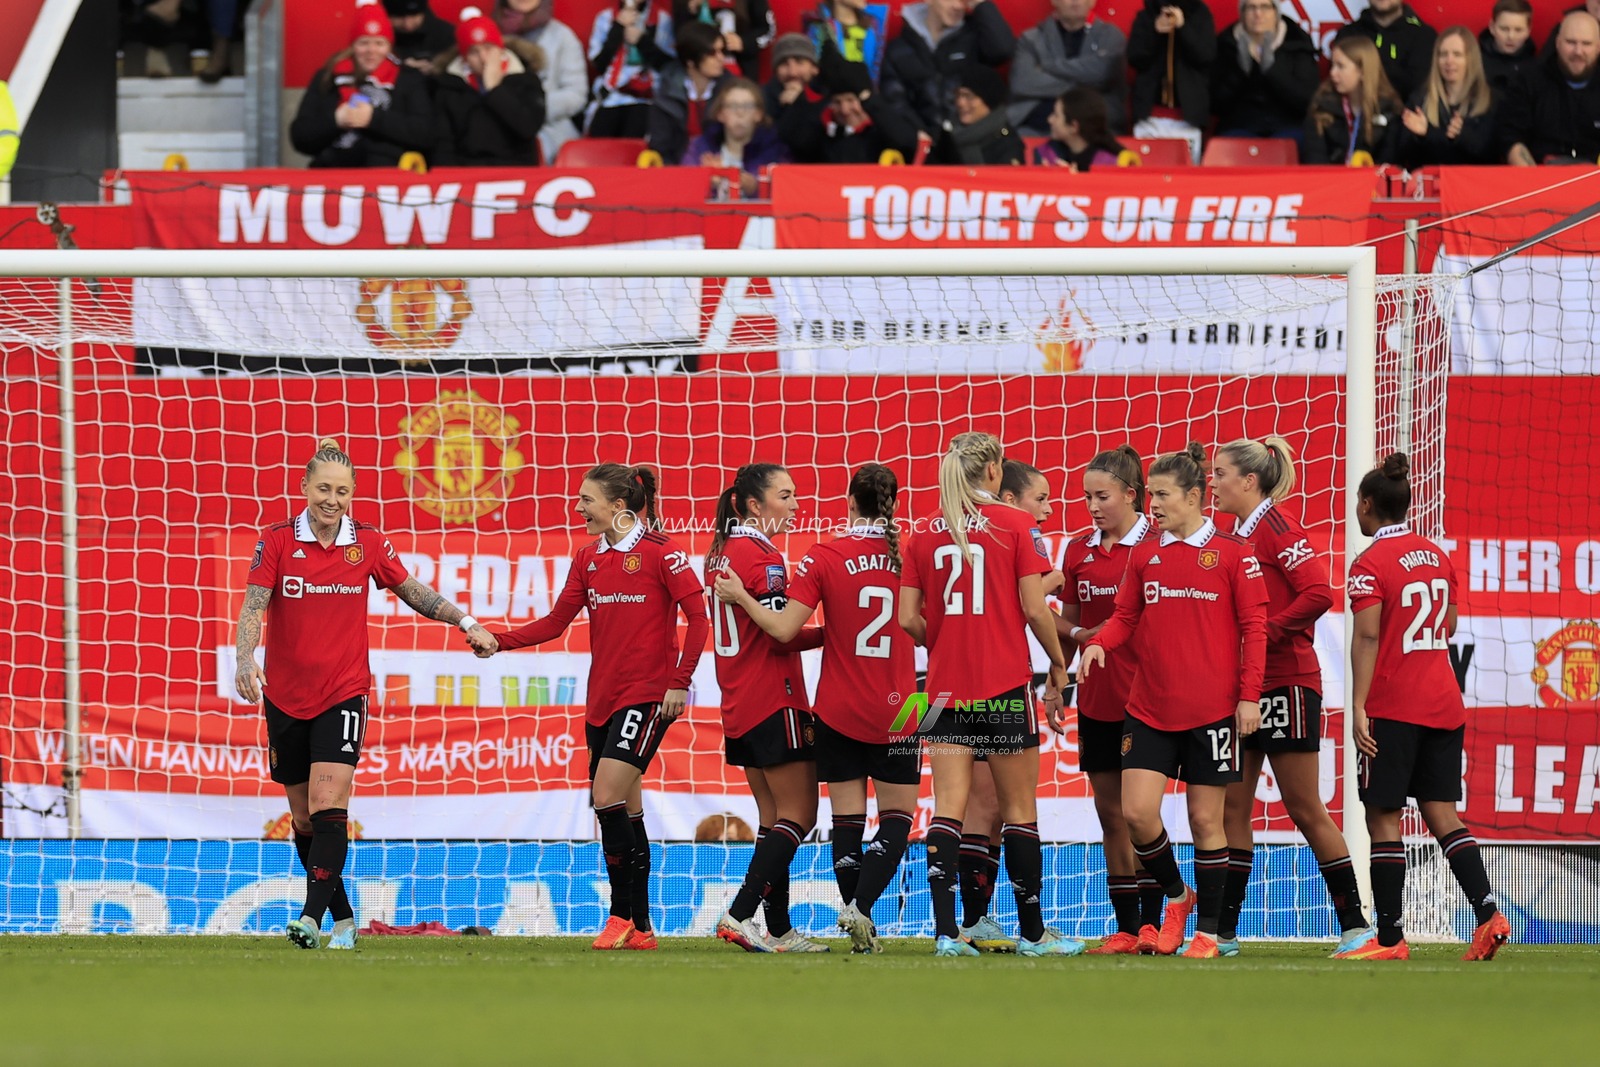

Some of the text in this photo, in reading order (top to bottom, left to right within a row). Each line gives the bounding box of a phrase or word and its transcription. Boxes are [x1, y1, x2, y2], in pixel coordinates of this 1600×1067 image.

[218, 176, 596, 246] MUWFC
[841, 184, 1304, 244] TOONEY'S ON FIRE
[933, 543, 985, 615] 21
[1469, 538, 1561, 594] HER
[303, 583, 363, 595] TeamViewer
[595, 592, 647, 604] TeamViewer
[1159, 586, 1219, 601] TeamViewer
[855, 585, 895, 659] 2
[1401, 578, 1450, 655] 22
[341, 709, 360, 741] 11
[620, 709, 643, 740] 6
[1259, 696, 1290, 729] 23
[34, 731, 135, 768] WEN
[145, 740, 271, 778] HANNA
[399, 733, 576, 776] MARCHING
[1207, 727, 1232, 760] 12
